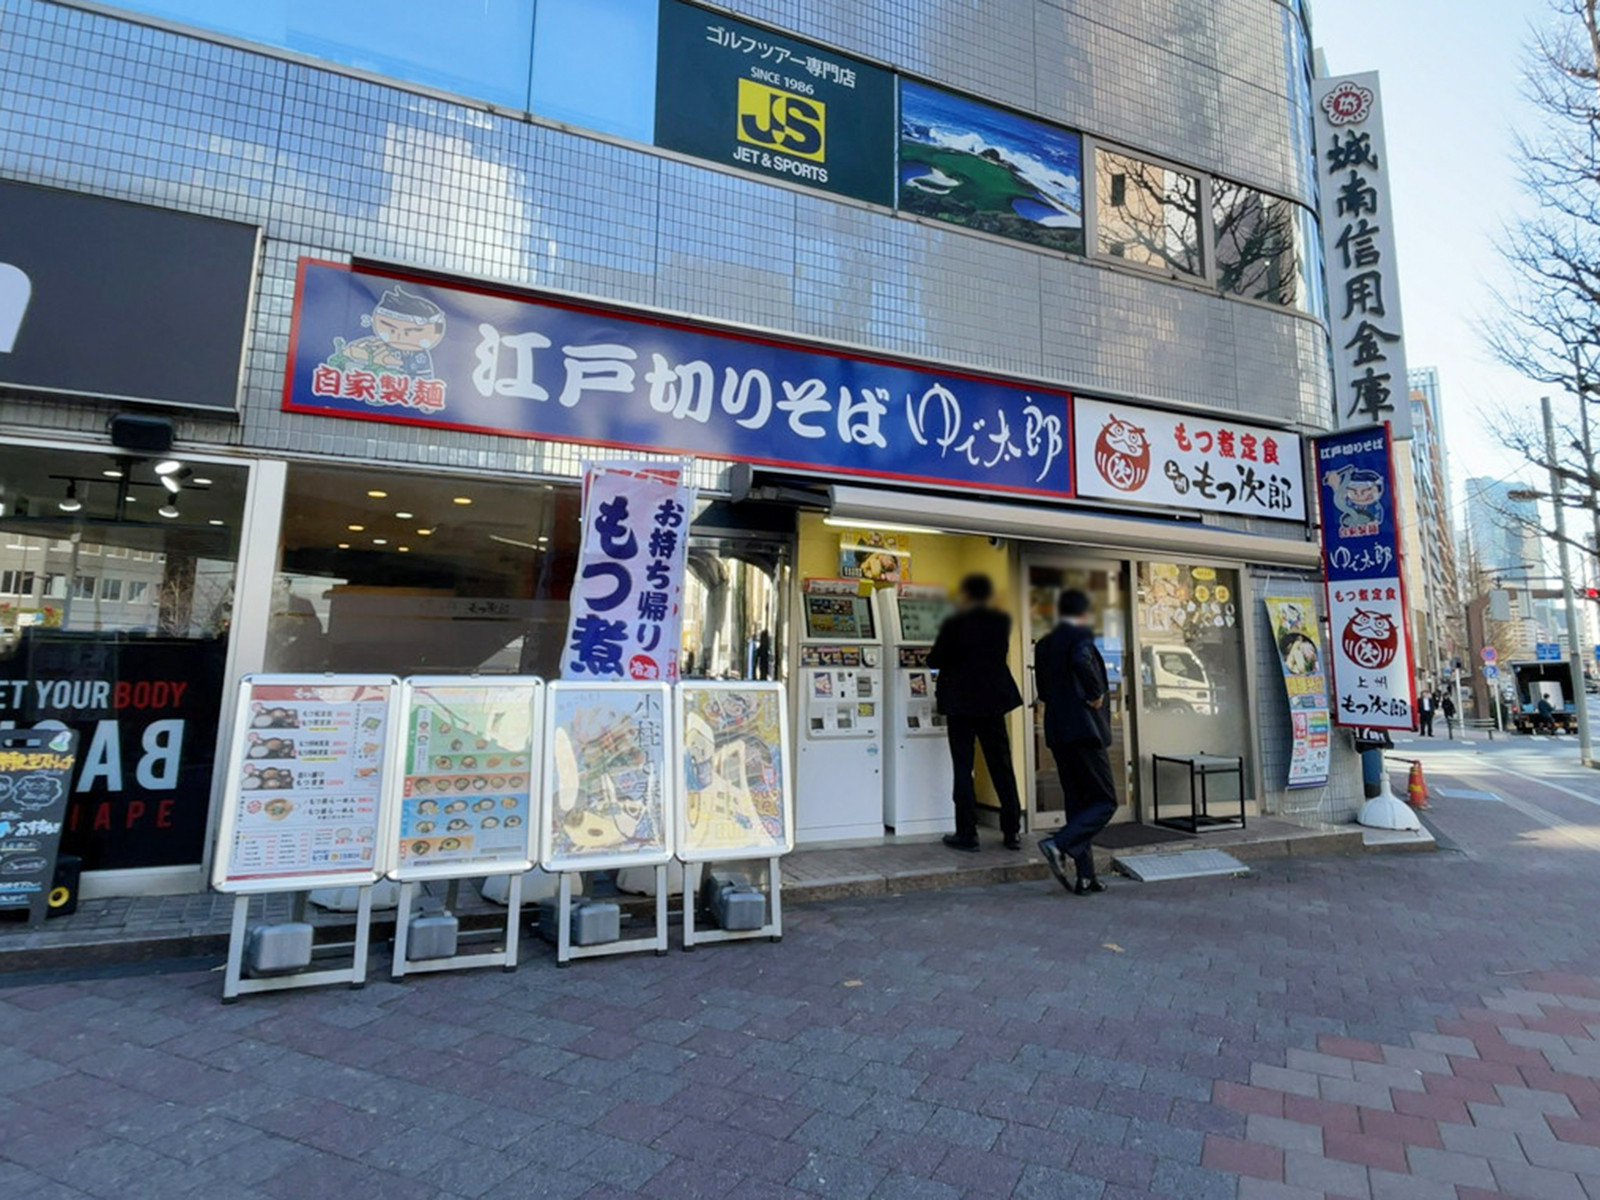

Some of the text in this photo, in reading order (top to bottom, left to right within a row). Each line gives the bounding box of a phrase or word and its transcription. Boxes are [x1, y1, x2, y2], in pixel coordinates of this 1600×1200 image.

[706, 24, 857, 88] ゴルフツアー専門店
[750, 66, 814, 96] SINCE 1986
[733, 149, 828, 183] JET & SPORTS
[1326, 129, 1401, 422] 城南信用金庫
[312, 364, 448, 413] 自家製麺
[471, 323, 1063, 483] 江戸切りそば ゆで太郎
[1173, 421, 1280, 465] もつ煮定食
[1320, 437, 1384, 459] 江戸切りそば
[1192, 461, 1292, 512] もつ次郎
[637, 499, 685, 652] お持ち帰り
[1330, 541, 1392, 573] ゆで太郎
[570, 496, 638, 677] もつ煮
[36, 681, 112, 709] YOUR
[115, 681, 189, 709] BODY
[1341, 694, 1407, 718] もつ次郎
